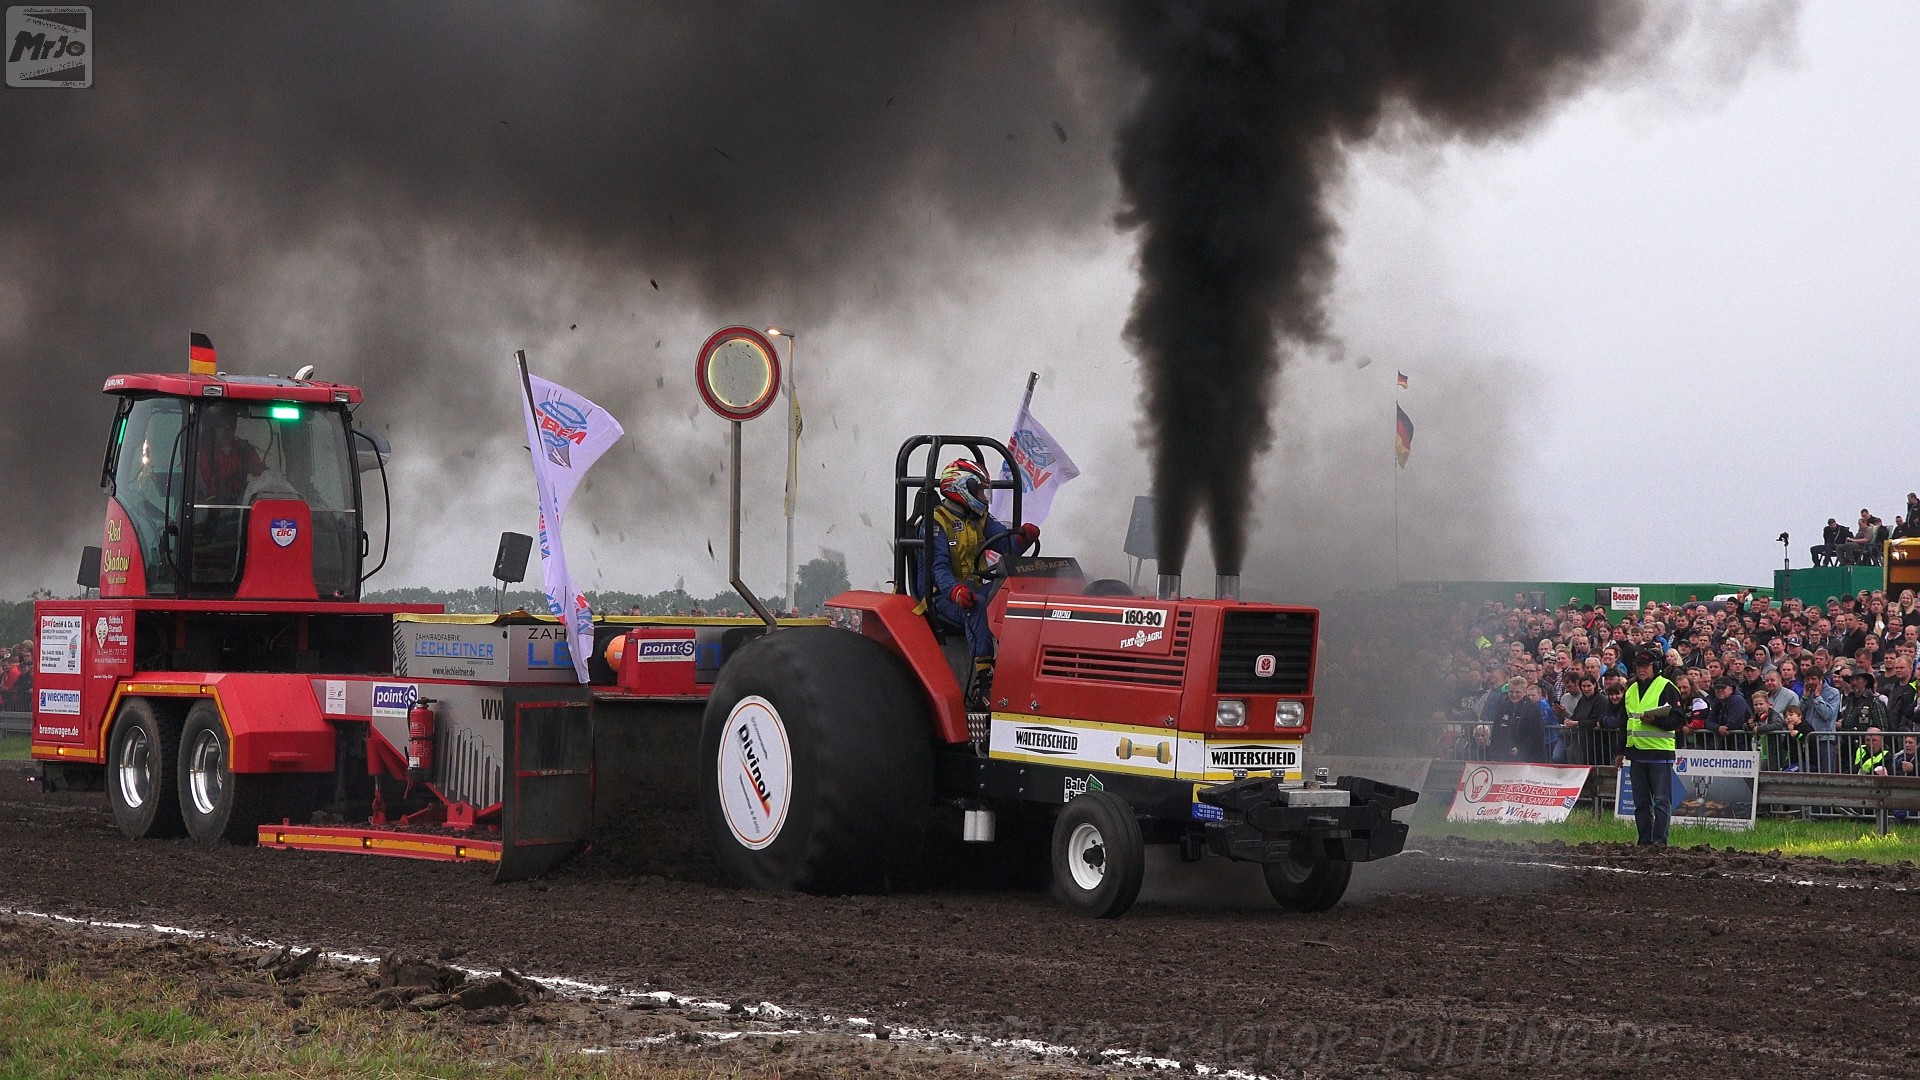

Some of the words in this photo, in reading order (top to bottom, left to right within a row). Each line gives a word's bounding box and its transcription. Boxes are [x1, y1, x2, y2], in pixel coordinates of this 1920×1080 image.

[107, 519, 122, 542] Red
[103, 549, 130, 573] Shadow
[1612, 591, 1639, 601] Benner
[1124, 609, 1161, 626] 160-90
[415, 633, 460, 642] ZAHNRADFABRIK
[1120, 637, 1135, 649] FIAT
[1146, 630, 1163, 642] AGRI
[414, 641, 494, 658] LECHLEITNER
[643, 643, 677, 654] point
[432, 666, 476, 677] www.lechleitner.de
[376, 688, 403, 705] point
[39, 724, 79, 738] bremswagen.de
[1015, 730, 1079, 751] WALTERSCHEID
[738, 722, 772, 803] Divinol
[1210, 751, 1296, 766] WALTERSCHEID
[1065, 778, 1086, 791] Bale
[1505, 805, 1541, 820] Winkler
